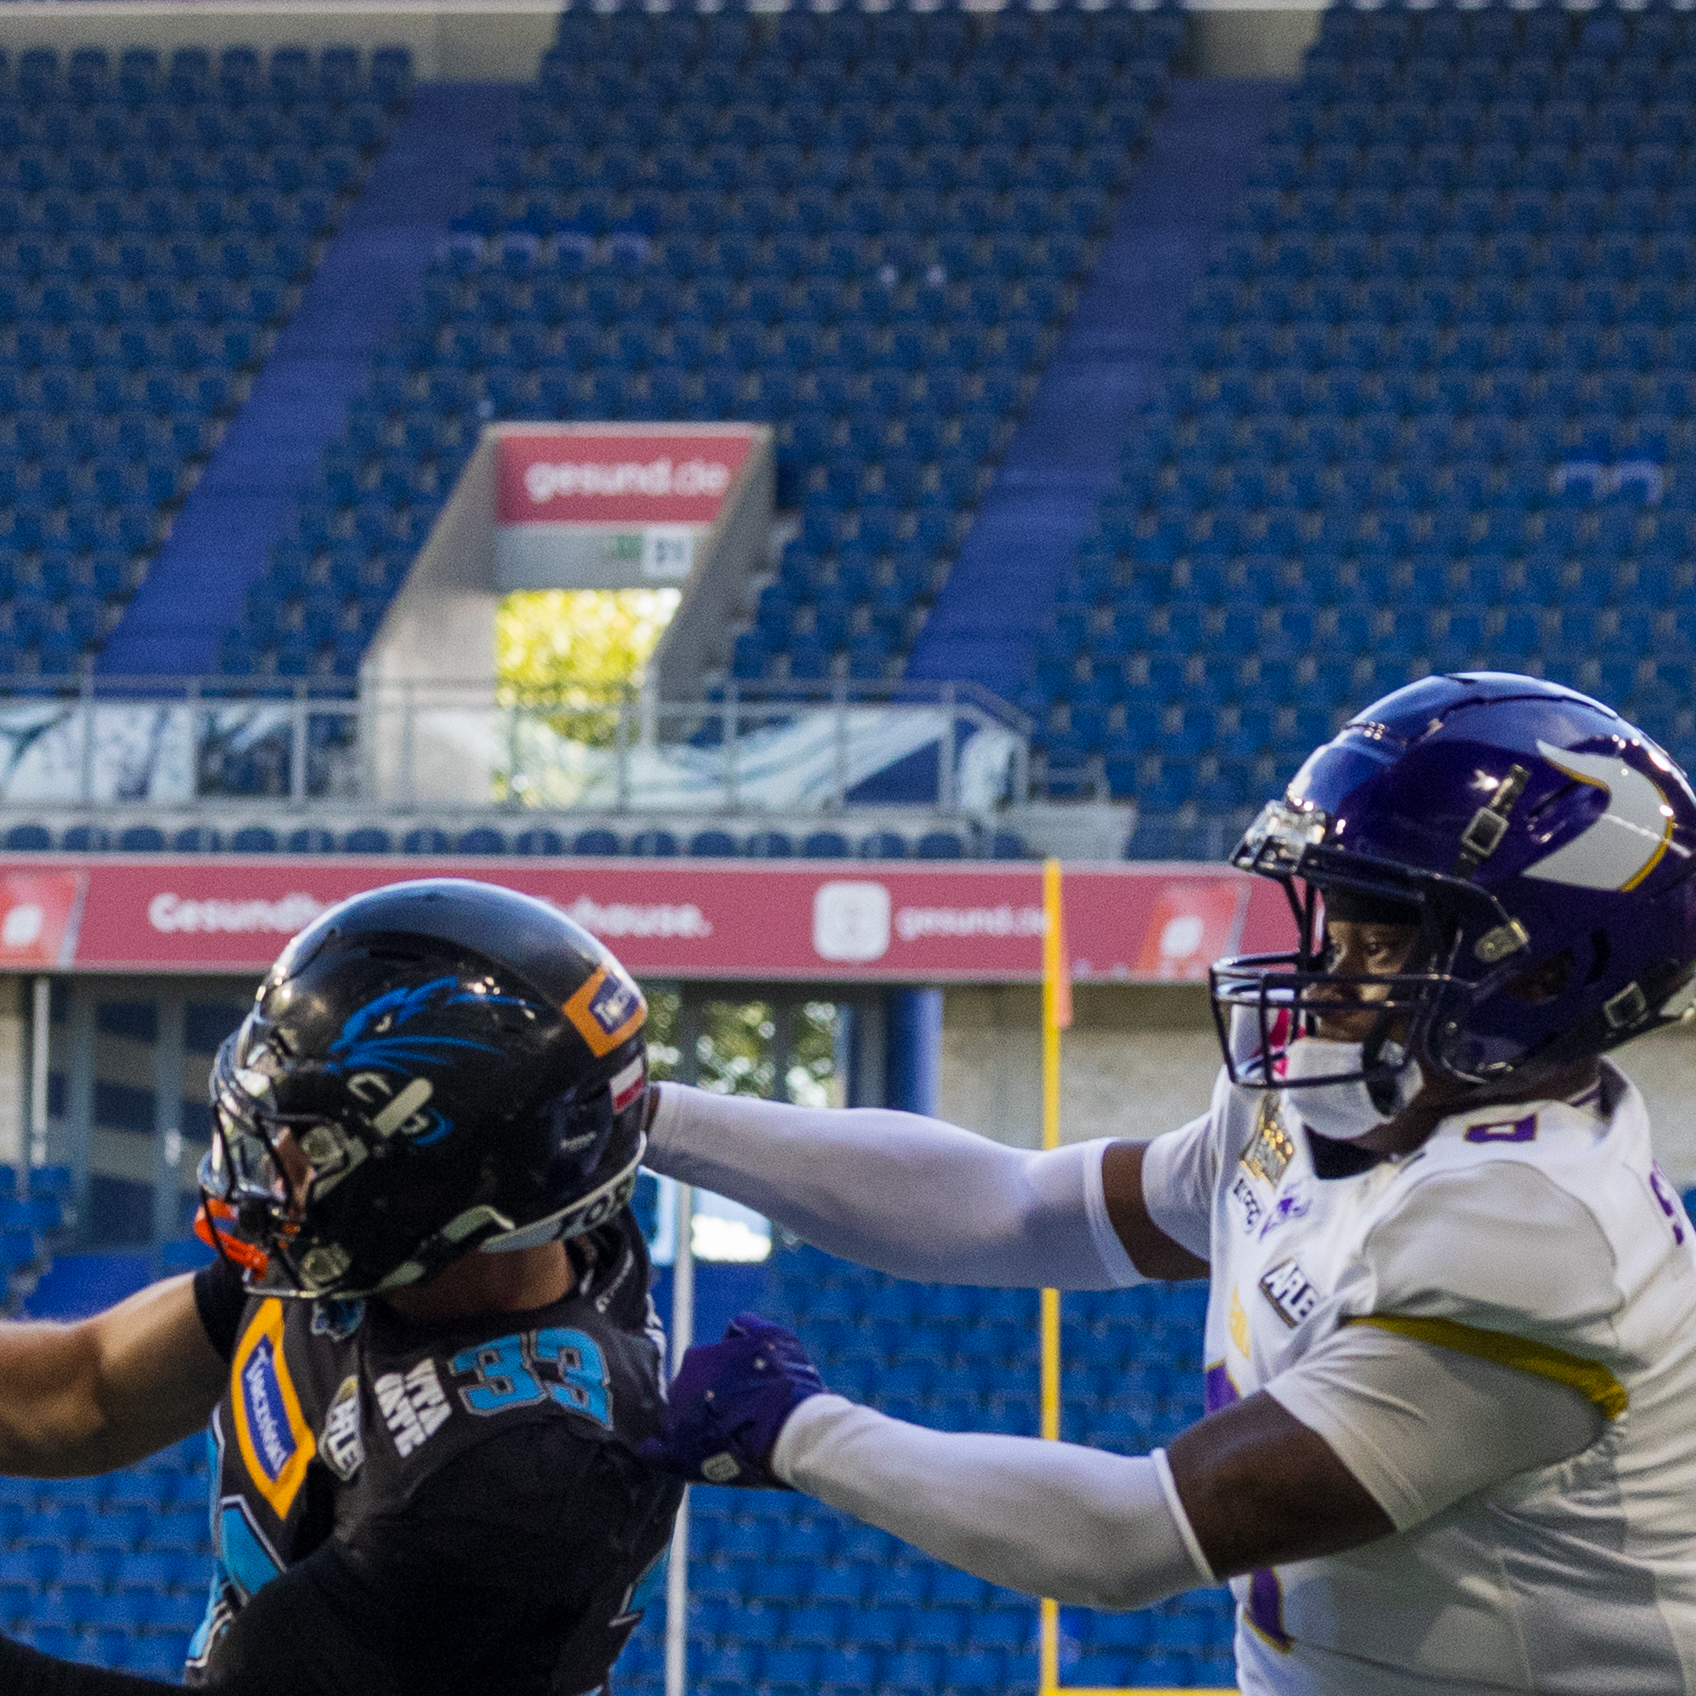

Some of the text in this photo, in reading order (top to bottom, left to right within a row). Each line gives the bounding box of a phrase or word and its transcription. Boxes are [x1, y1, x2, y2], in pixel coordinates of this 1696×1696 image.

[524, 456, 731, 503] gesund.de
[897, 904, 1046, 941] gesund.d
[447, 1327, 614, 1432] 33
